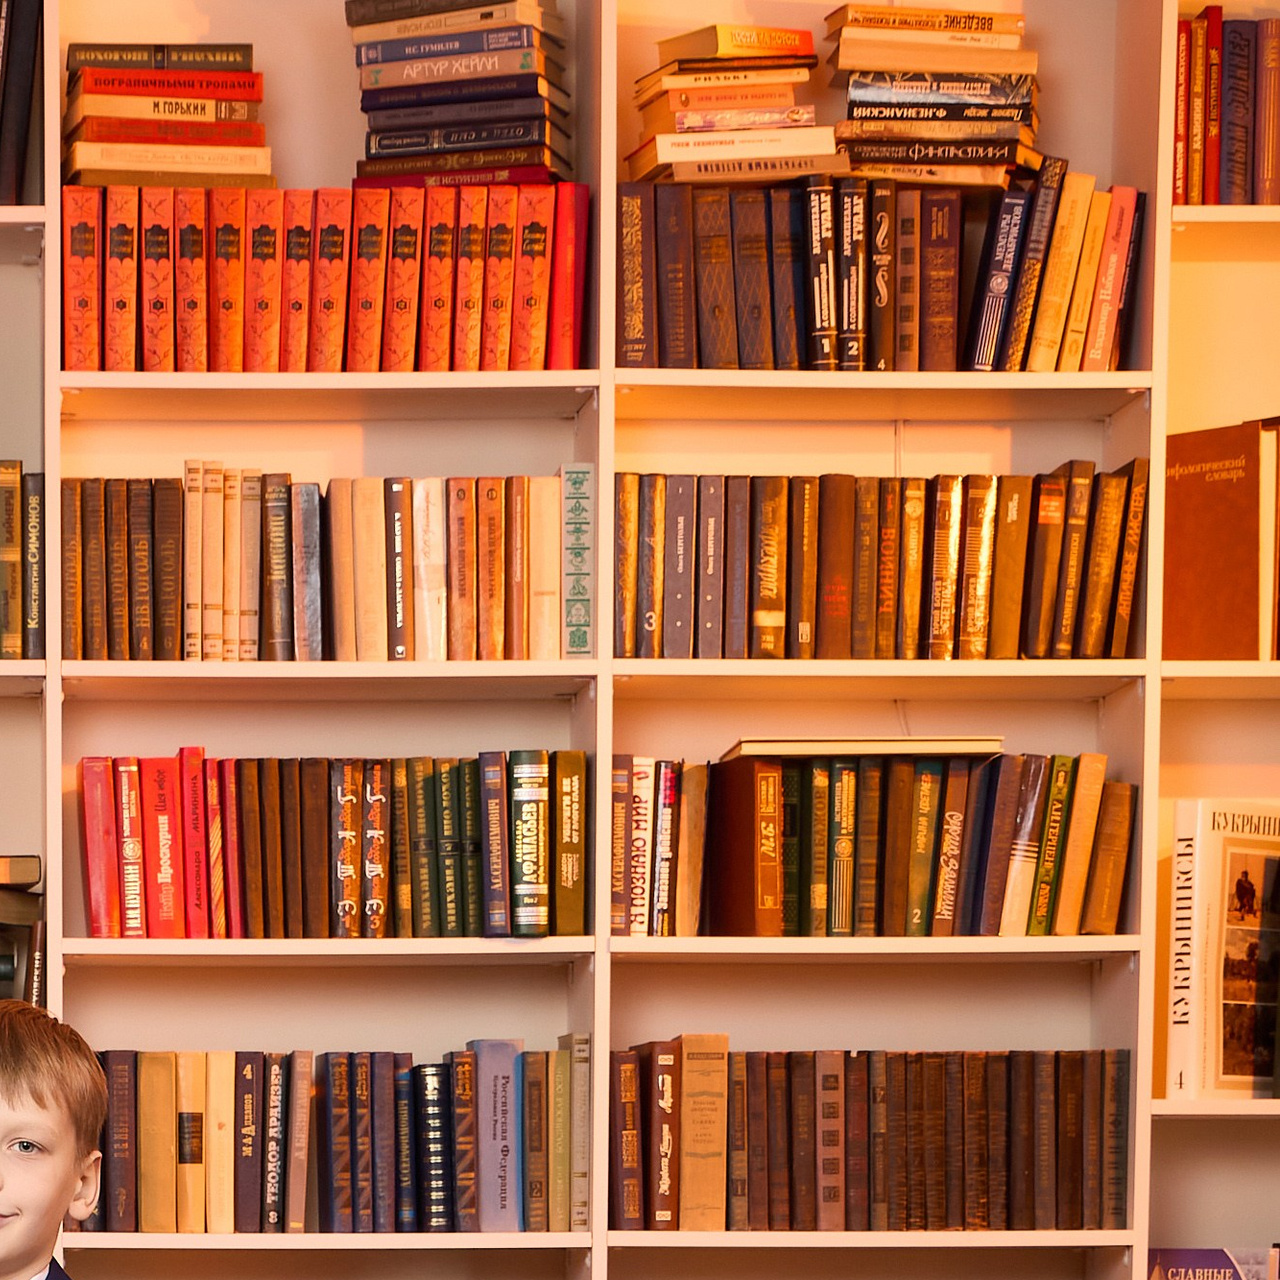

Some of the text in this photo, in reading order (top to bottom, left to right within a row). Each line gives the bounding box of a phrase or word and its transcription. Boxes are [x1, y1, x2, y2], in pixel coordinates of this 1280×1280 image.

[943, 14, 993, 31] ВВЕДЕНИЕ
[402, 60, 447, 79] АРТУР
[1228, 30, 1251, 119] ФОЛКНЕР
[162, 101, 206, 116] ГОРЬКИЙ
[853, 106, 947, 119] Ф.НЕЗНАНСКИЙ
[821, 193, 832, 238] ГУЛАГ
[853, 194, 864, 240] ГУЛАГ
[992, 205, 1022, 271] МЕМУАРЫ ДЕКАБРИСТОВ
[1205, 469, 1246, 483] словарь
[28, 495, 40, 629] Константин СИМОНОВ
[880, 527, 895, 614] ВОЙНИЧ
[1117, 482, 1146, 620] АНТИЧНЫЕ МАСТЕРА
[522, 802, 537, 883] АФАНАСЬЕВ
[631, 795, 648, 925] Я ПОЗНАЮ МИР
[194, 852, 202, 911] Александра
[657, 860, 669, 911] Заказное
[1173, 837, 1194, 1025] КУКРЫНИКСЫ
[266, 1064, 282, 1204] ТЕОДОР ДРАЙЗЕР
[498, 1074, 510, 1210] Российская Федерация
